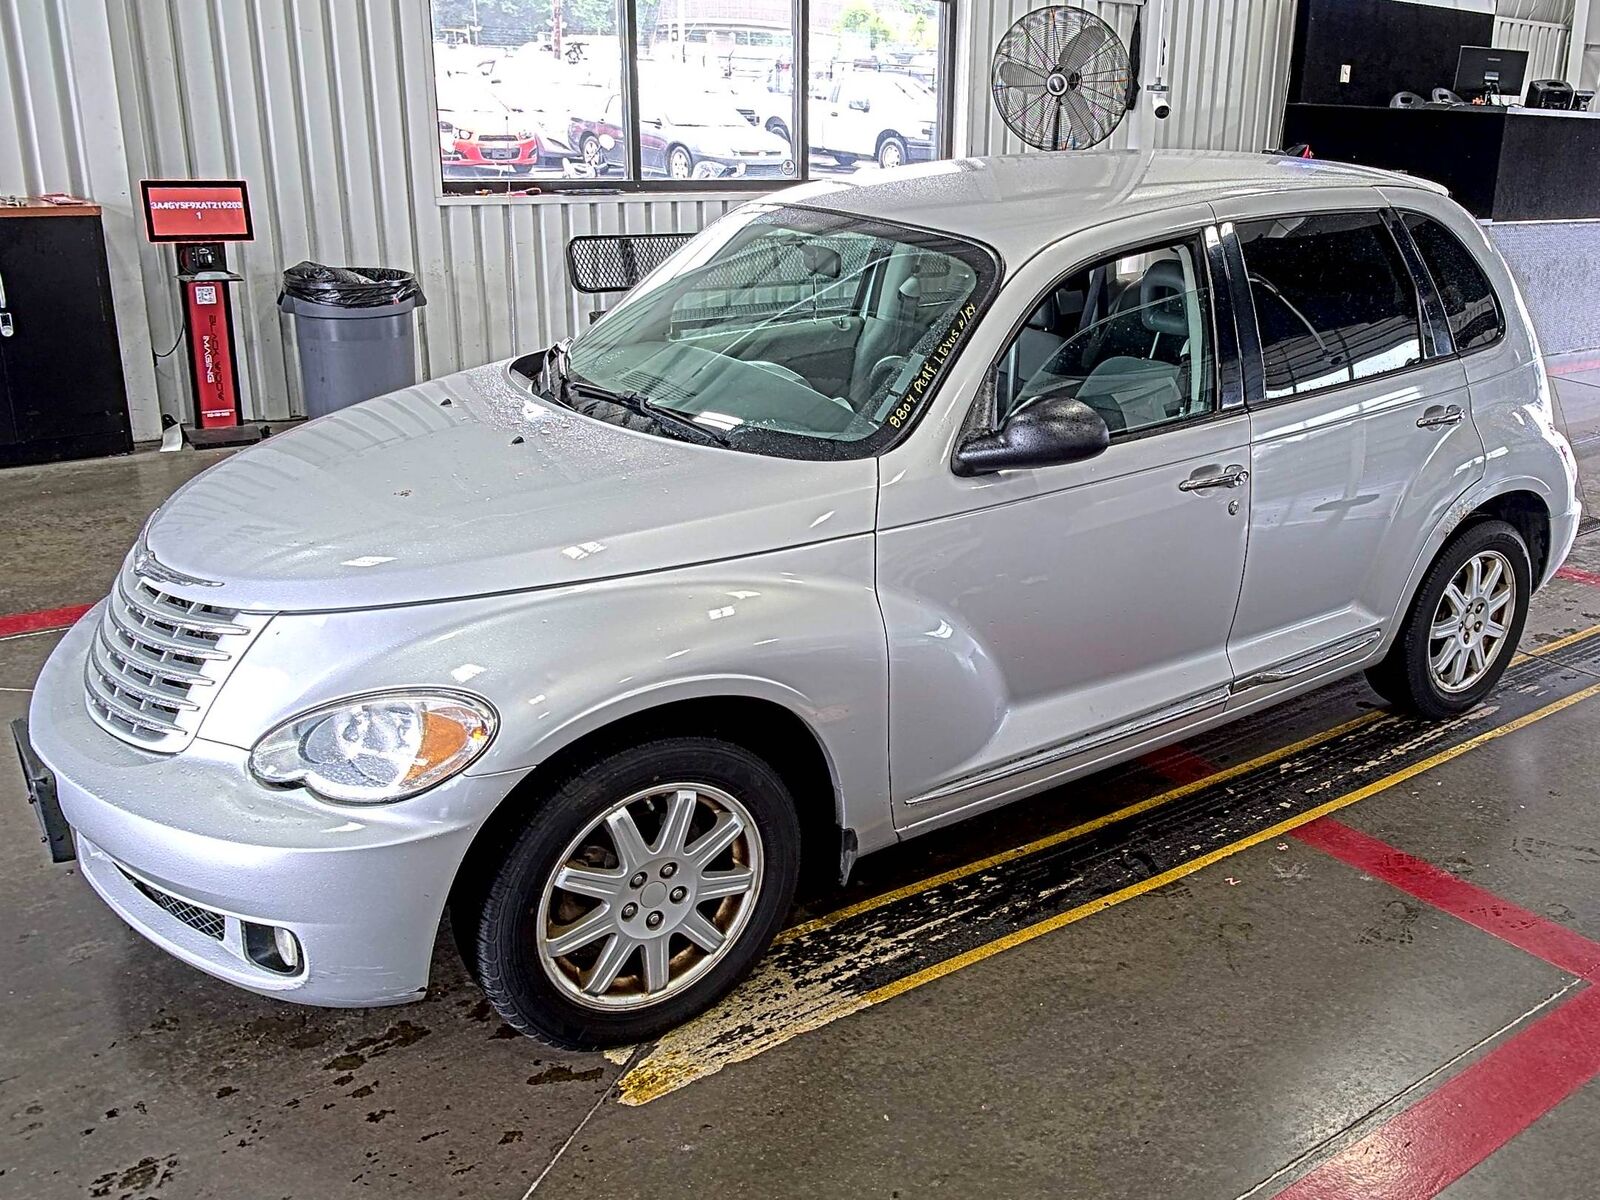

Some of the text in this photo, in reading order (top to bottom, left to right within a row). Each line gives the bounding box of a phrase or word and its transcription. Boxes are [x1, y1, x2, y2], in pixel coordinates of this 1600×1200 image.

[196, 212, 202, 220] 1
[202, 335, 215, 384] IMAGING
[889, 394, 916, 428] 8804
